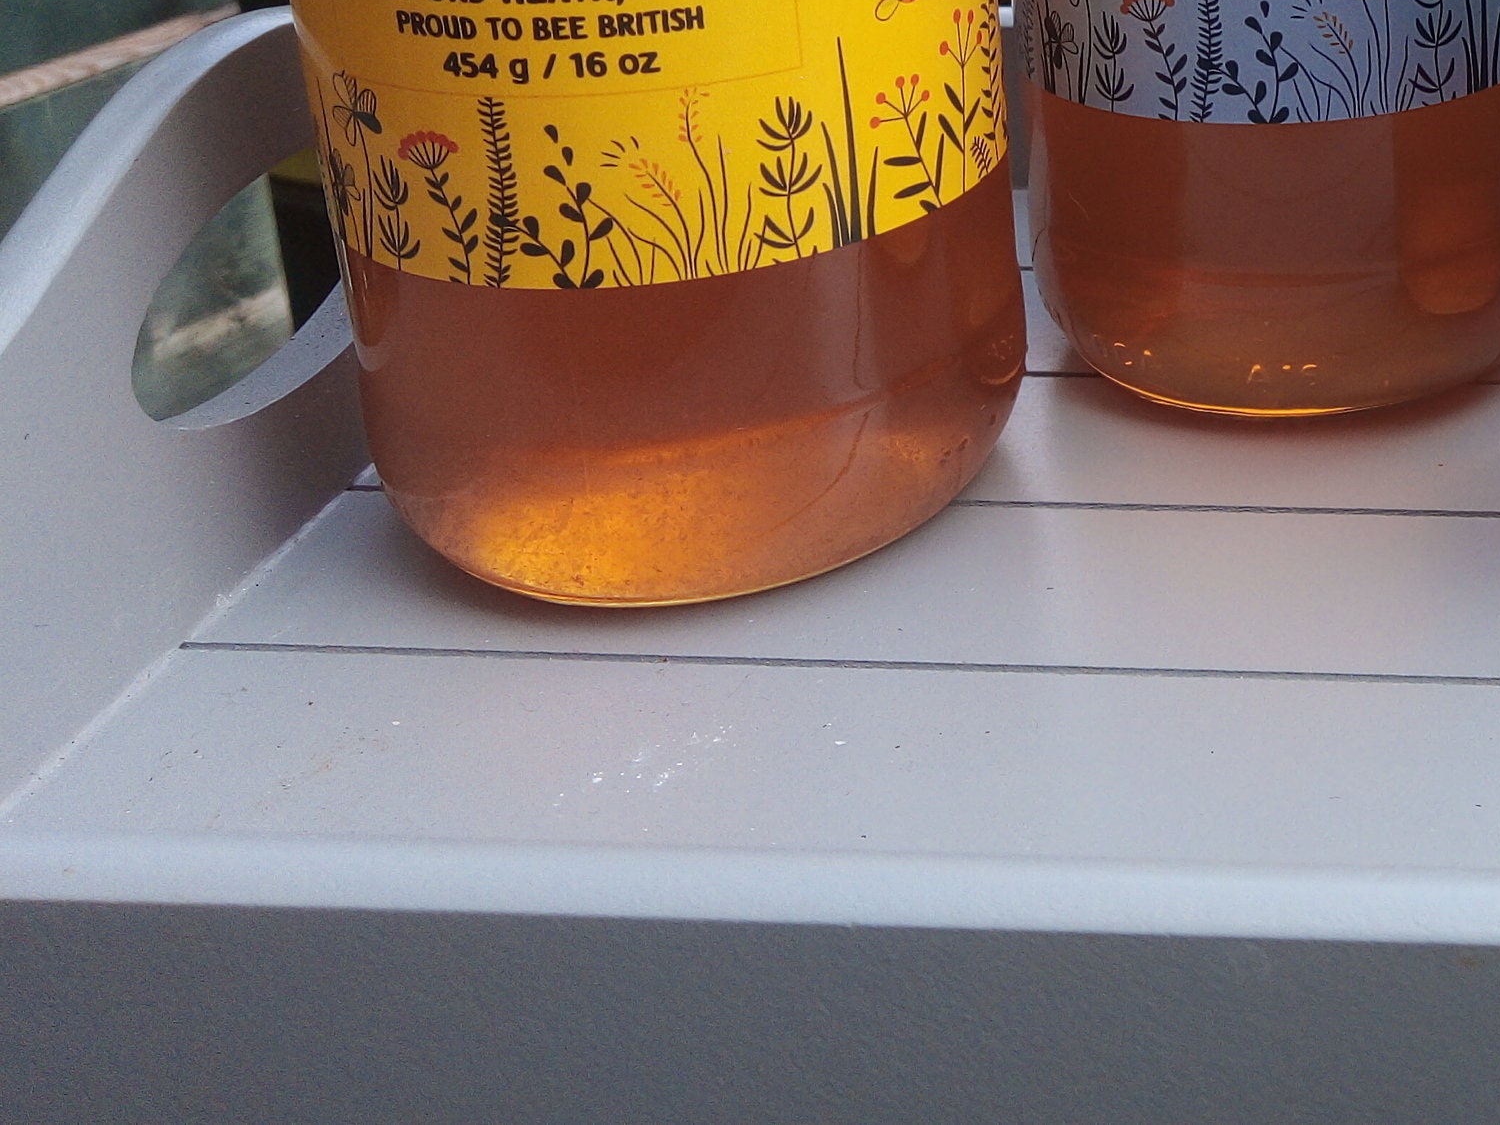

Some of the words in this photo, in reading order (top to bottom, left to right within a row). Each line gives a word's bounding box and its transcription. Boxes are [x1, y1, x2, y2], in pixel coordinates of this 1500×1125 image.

[396, 10, 477, 41] PROUD
[485, 16, 522, 42] TO
[532, 15, 588, 42] BEE
[598, 6, 704, 39] BRITISH
[443, 51, 498, 79] 454
[509, 58, 529, 85] g
[543, 54, 556, 80] /
[570, 52, 607, 79] 16
[619, 51, 660, 76] oz
